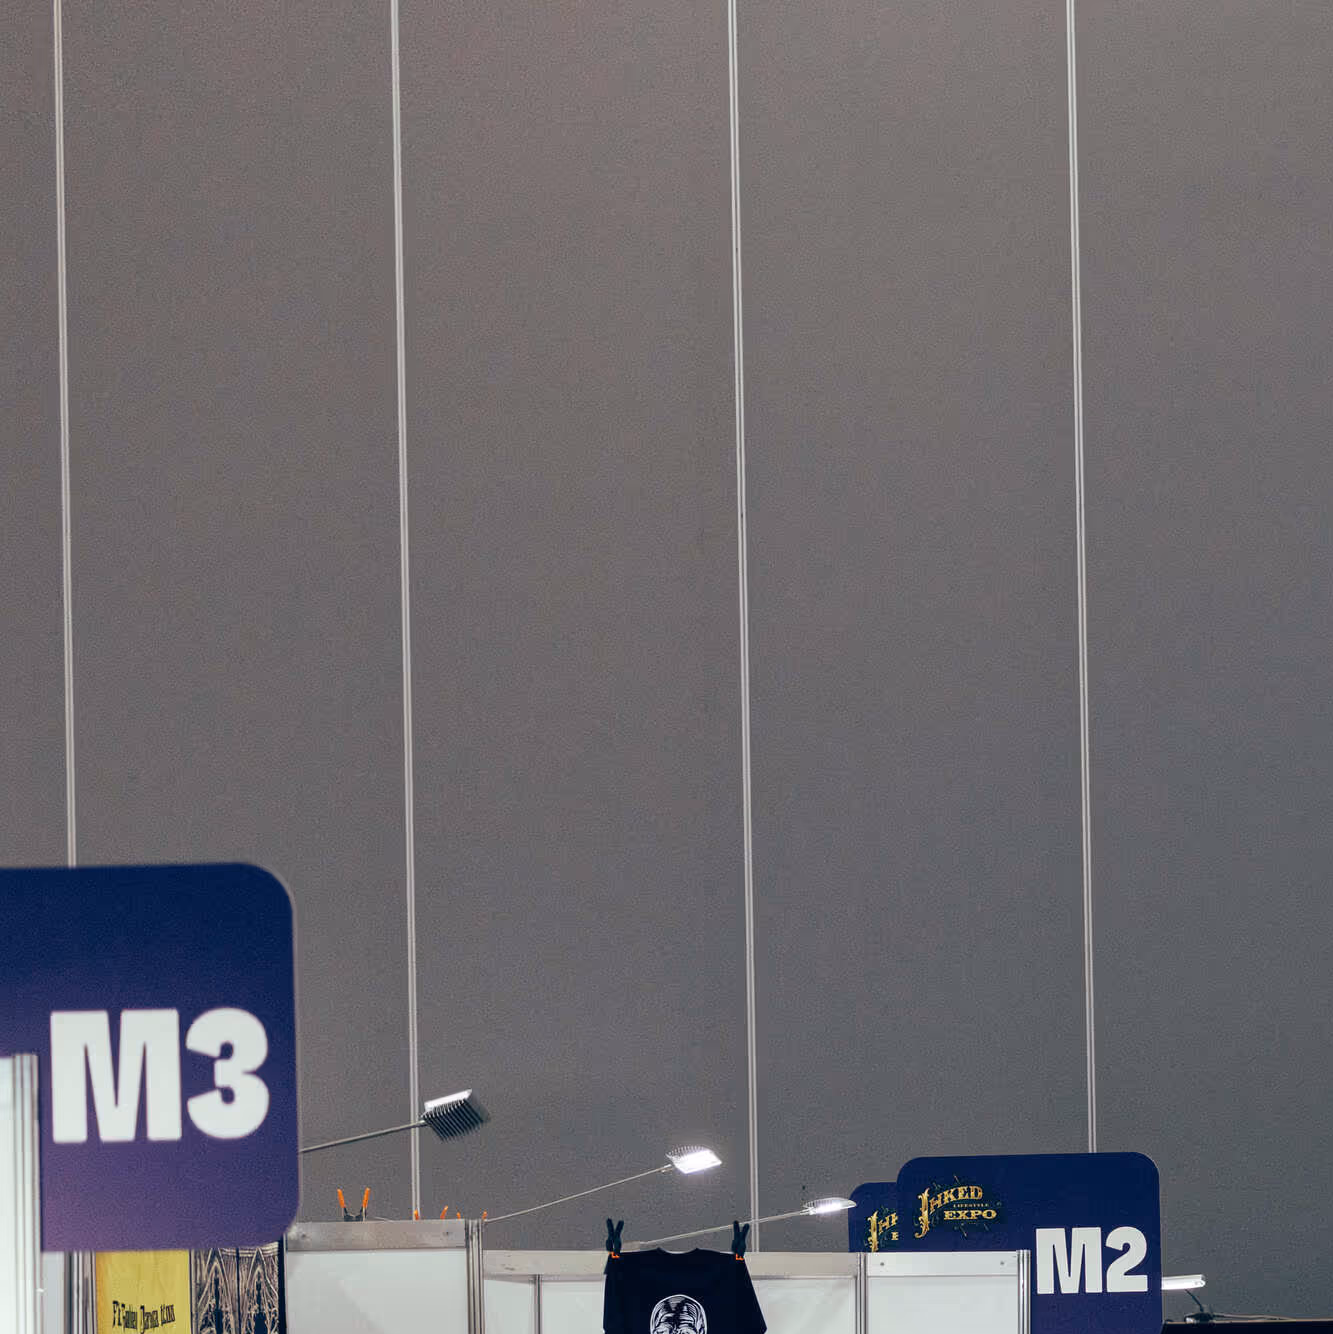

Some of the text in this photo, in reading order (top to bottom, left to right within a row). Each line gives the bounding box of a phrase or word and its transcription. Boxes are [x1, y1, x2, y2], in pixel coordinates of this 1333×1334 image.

[48, 1006, 271, 1145] M3
[914, 1184, 983, 1238] INKED
[943, 1208, 997, 1221] EXPO
[1035, 1226, 1148, 1295] M2
